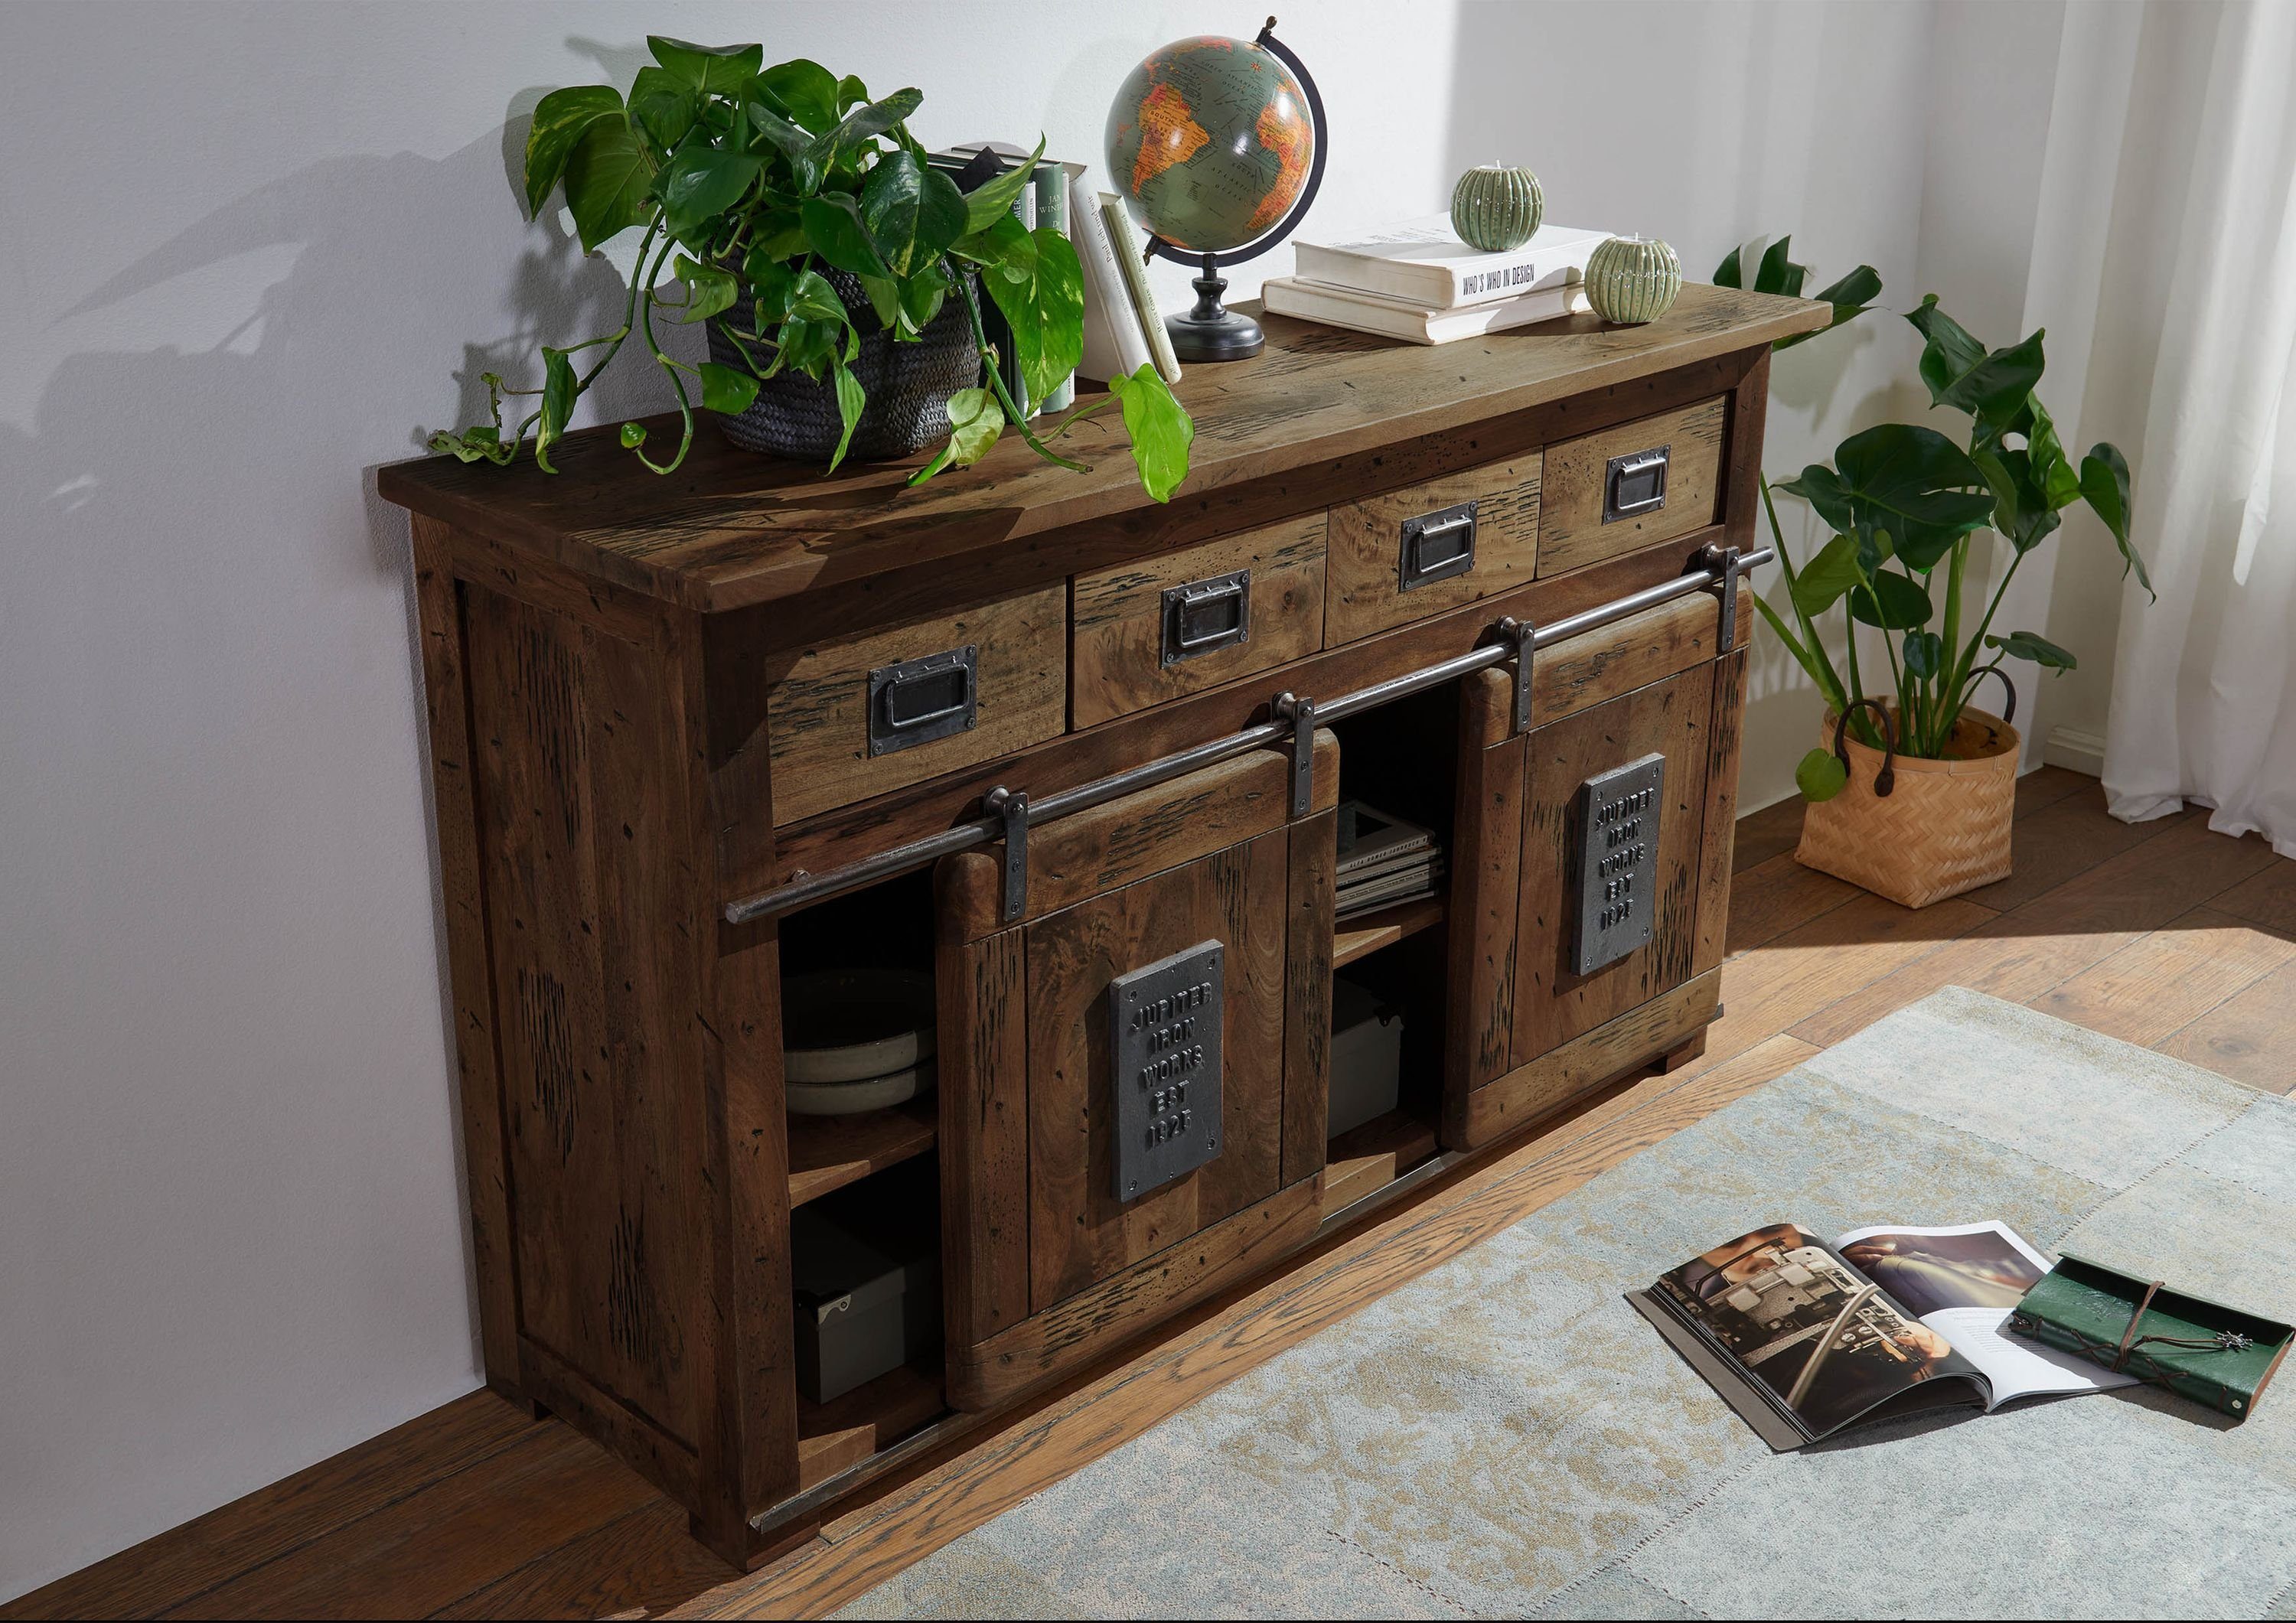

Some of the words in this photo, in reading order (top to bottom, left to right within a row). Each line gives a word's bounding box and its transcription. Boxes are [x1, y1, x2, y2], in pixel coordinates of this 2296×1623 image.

[1091, 210, 1101, 227] und
[1463, 273, 1484, 295] WHO'S
[1486, 270, 1501, 291] WHO
[1503, 269, 1510, 287] IN
[1512, 263, 1534, 285] DESIGN
[1131, 982, 1212, 1031] JUPITER
[1152, 1016, 1196, 1053] IRON
[1143, 1045, 1204, 1088] WORKS
[1154, 1080, 1190, 1111] EST
